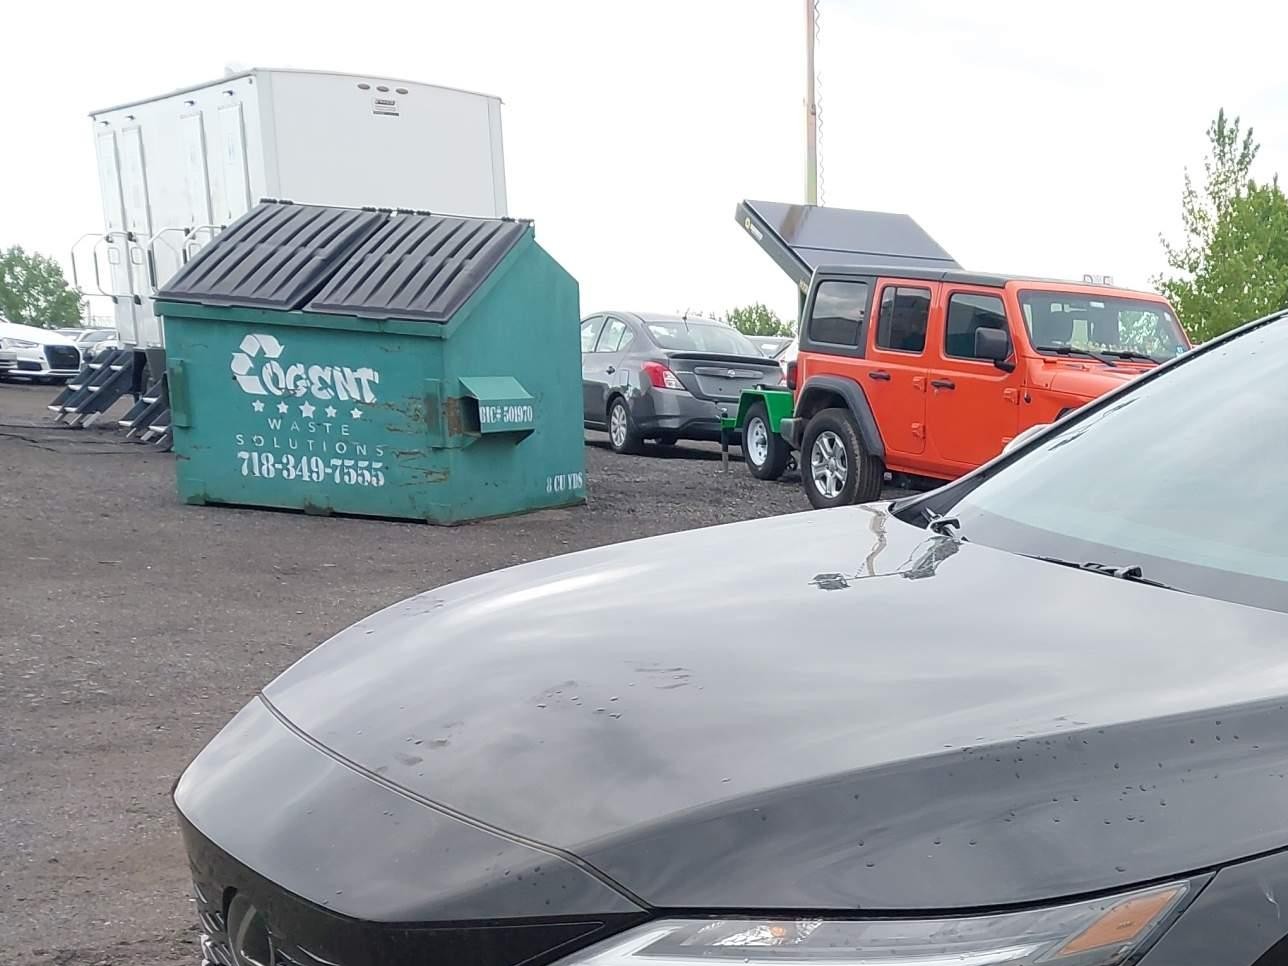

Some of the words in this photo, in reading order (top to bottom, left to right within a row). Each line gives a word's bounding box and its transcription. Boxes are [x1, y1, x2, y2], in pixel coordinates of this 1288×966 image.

[503, 405, 534, 423] 501970
[267, 417, 351, 436] WASTE
[235, 433, 385, 457] SOLUTIONS
[237, 451, 385, 487] 718-349-7555
[553, 474, 566, 493] CU
[567, 471, 584, 490] YDS
